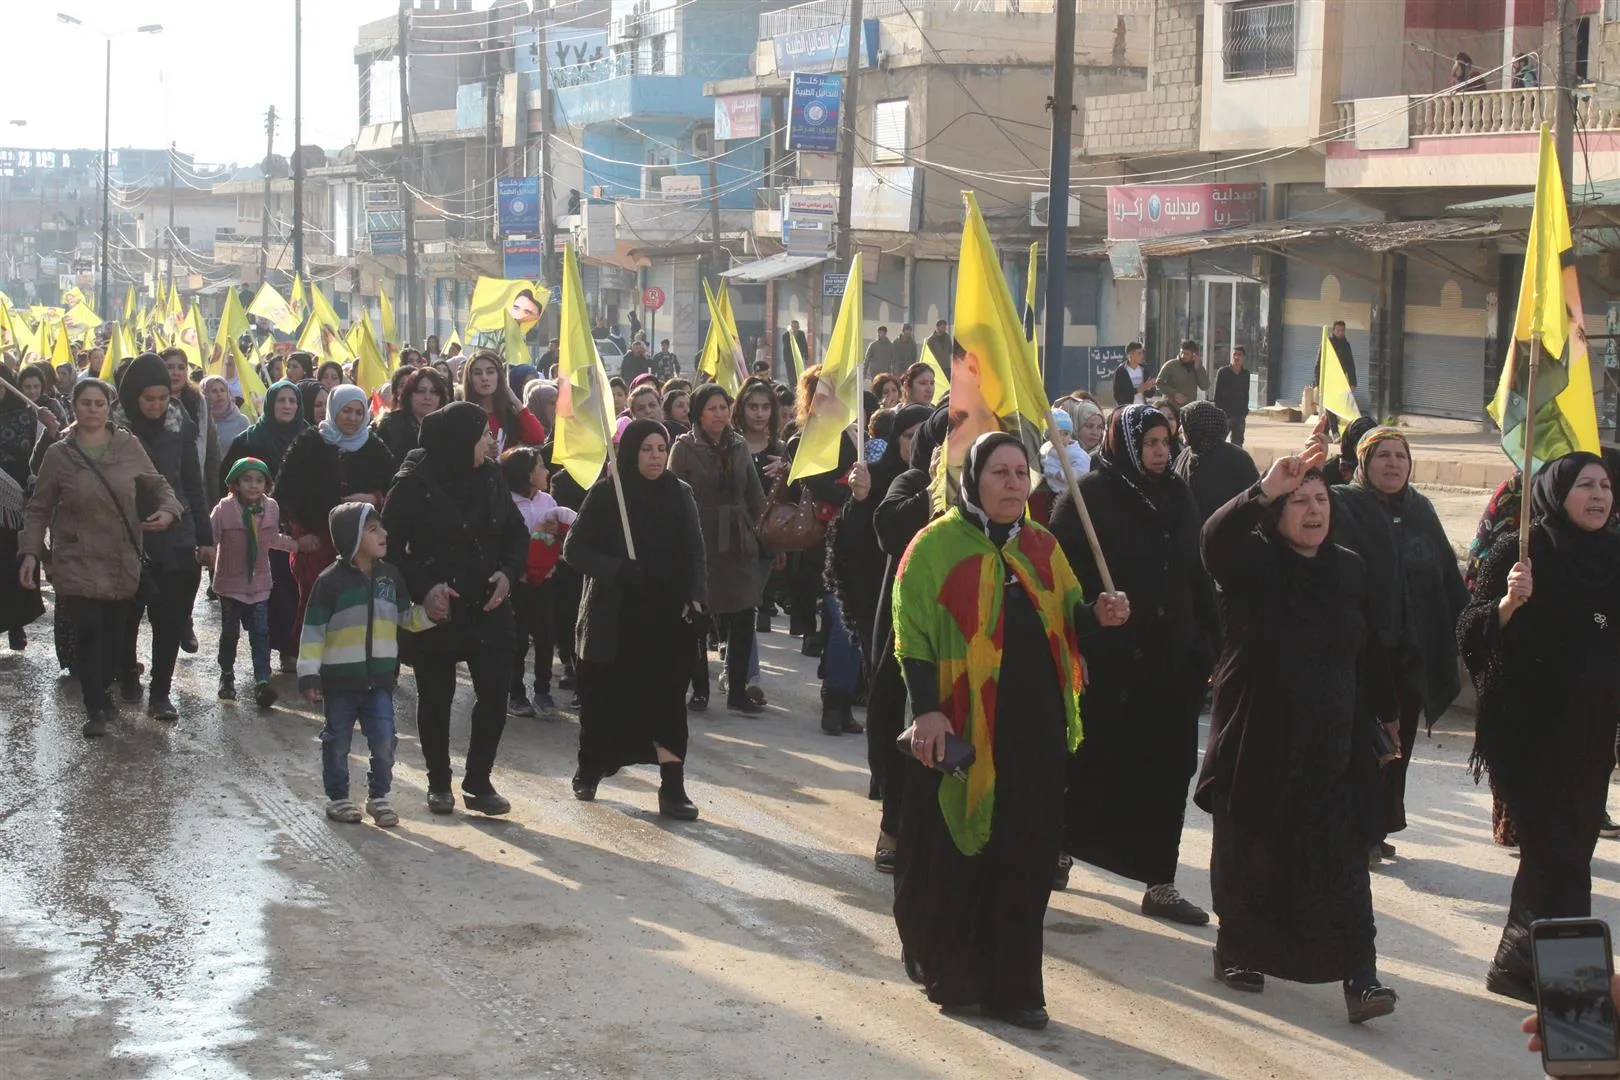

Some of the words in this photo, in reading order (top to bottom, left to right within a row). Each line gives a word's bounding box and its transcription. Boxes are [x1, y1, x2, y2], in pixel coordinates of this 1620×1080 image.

[1212, 187, 1258, 204] صيدلية
[1113, 197, 1143, 222] زكريا
[1164, 196, 1200, 220] صيدلية
[1094, 349, 1124, 363] يدلية
